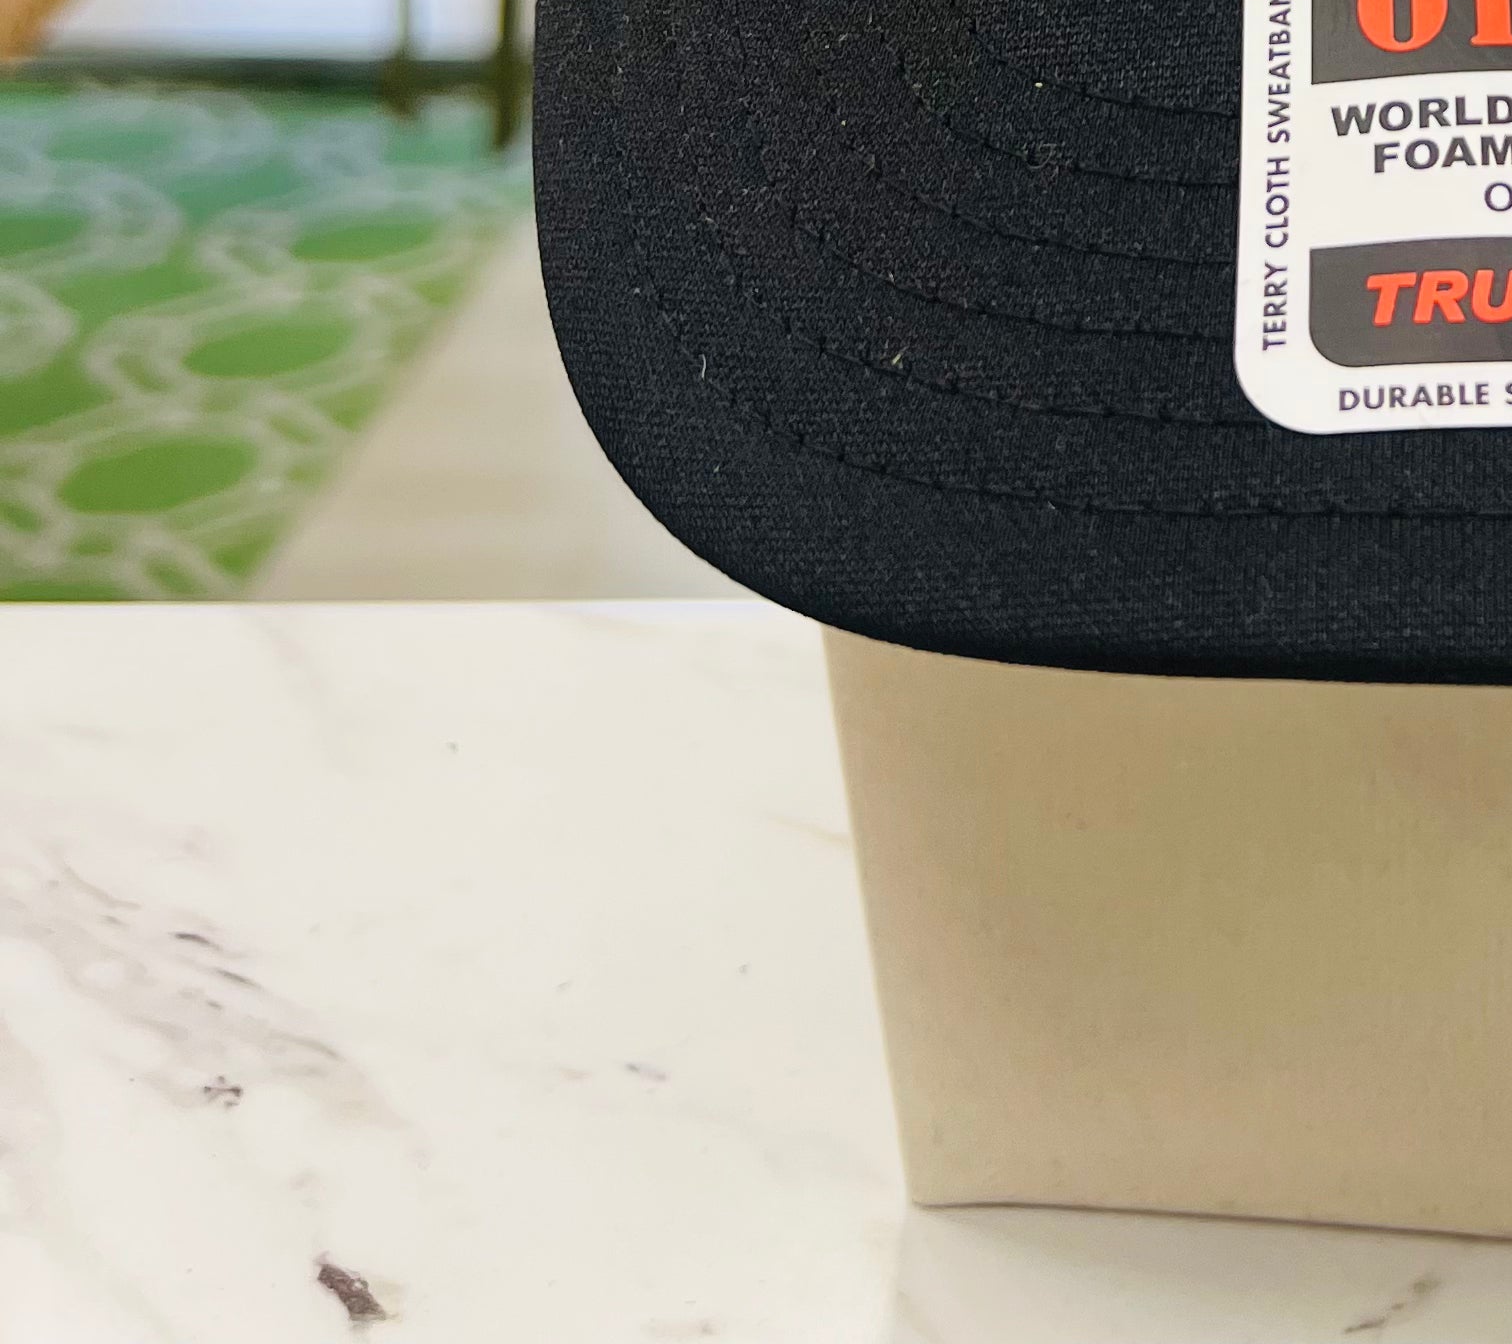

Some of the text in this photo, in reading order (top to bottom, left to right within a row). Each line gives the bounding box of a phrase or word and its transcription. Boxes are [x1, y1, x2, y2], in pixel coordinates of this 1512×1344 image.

[1265, 156, 1290, 248] CLOTH
[1262, 261, 1289, 351] TERRY
[1338, 382, 1489, 411] DURABLE
